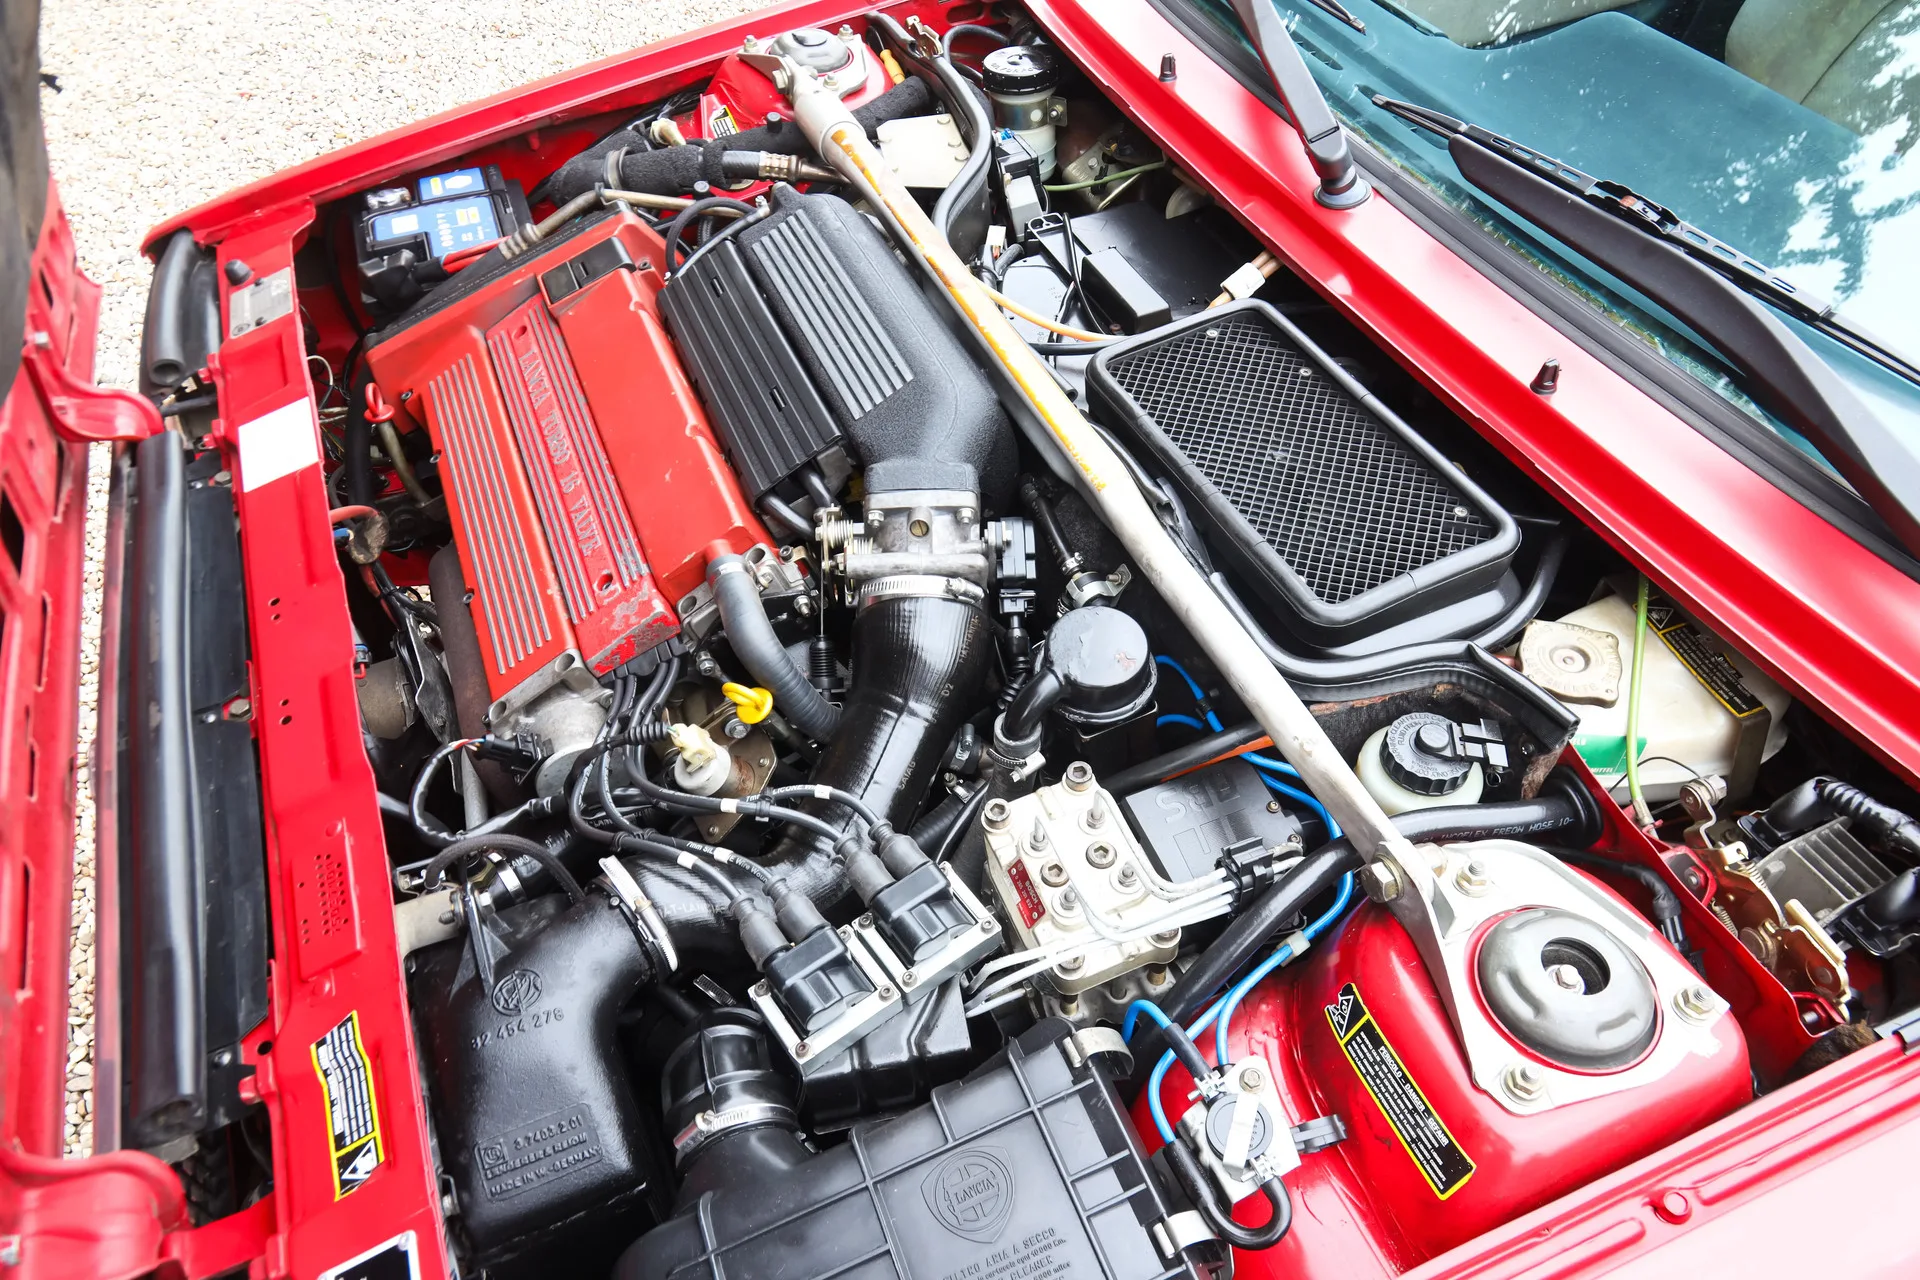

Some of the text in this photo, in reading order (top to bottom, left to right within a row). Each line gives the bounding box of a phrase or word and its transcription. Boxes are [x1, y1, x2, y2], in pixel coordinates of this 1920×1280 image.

[518, 350, 602, 557] LANCIA TURBO 16 VALVE
[1389, 717, 1407, 734] CLEAN
[1404, 713, 1429, 722] FILLER
[1431, 714, 1446, 723] CAP
[1396, 728, 1407, 745] FLUID
[1494, 826, 1524, 836] FREON
[1528, 820, 1554, 831] HOSE
[735, 856, 752, 871] Wire
[750, 866, 770, 882] Woun
[1024, 879, 1038, 904] BOSCH
[1378, 1044, 1449, 1146] PERICOLO DANGER GEFAHR
[489, 1176, 521, 1196] MADE
[953, 1178, 996, 1205] LANCIA
[986, 1249, 1009, 1268] ARIA
[1012, 1244, 1020, 1255] A
[1022, 1227, 1056, 1250] SECCO
[1010, 1254, 1053, 1280] CLEANER
